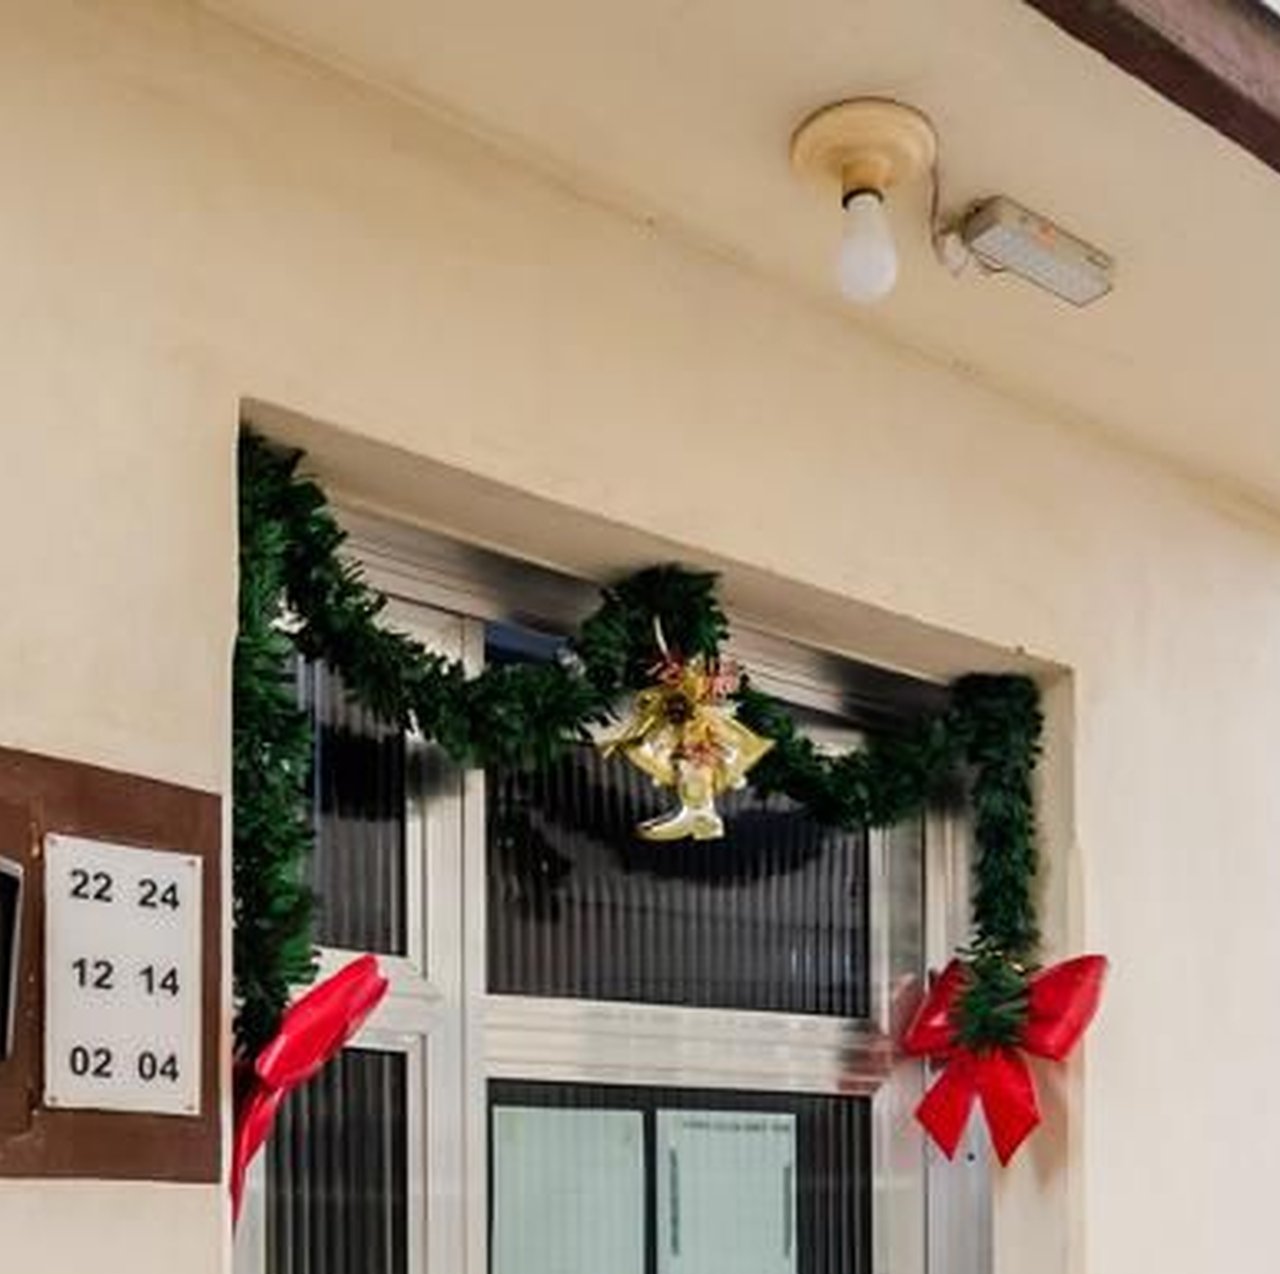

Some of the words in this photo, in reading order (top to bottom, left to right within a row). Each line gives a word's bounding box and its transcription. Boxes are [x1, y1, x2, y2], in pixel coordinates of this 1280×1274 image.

[70, 869, 114, 903] 22
[137, 878, 180, 910] 24
[72, 958, 114, 990] 12
[139, 965, 180, 996] 14
[70, 1046, 113, 1079] 02
[137, 1052, 180, 1082] 04
